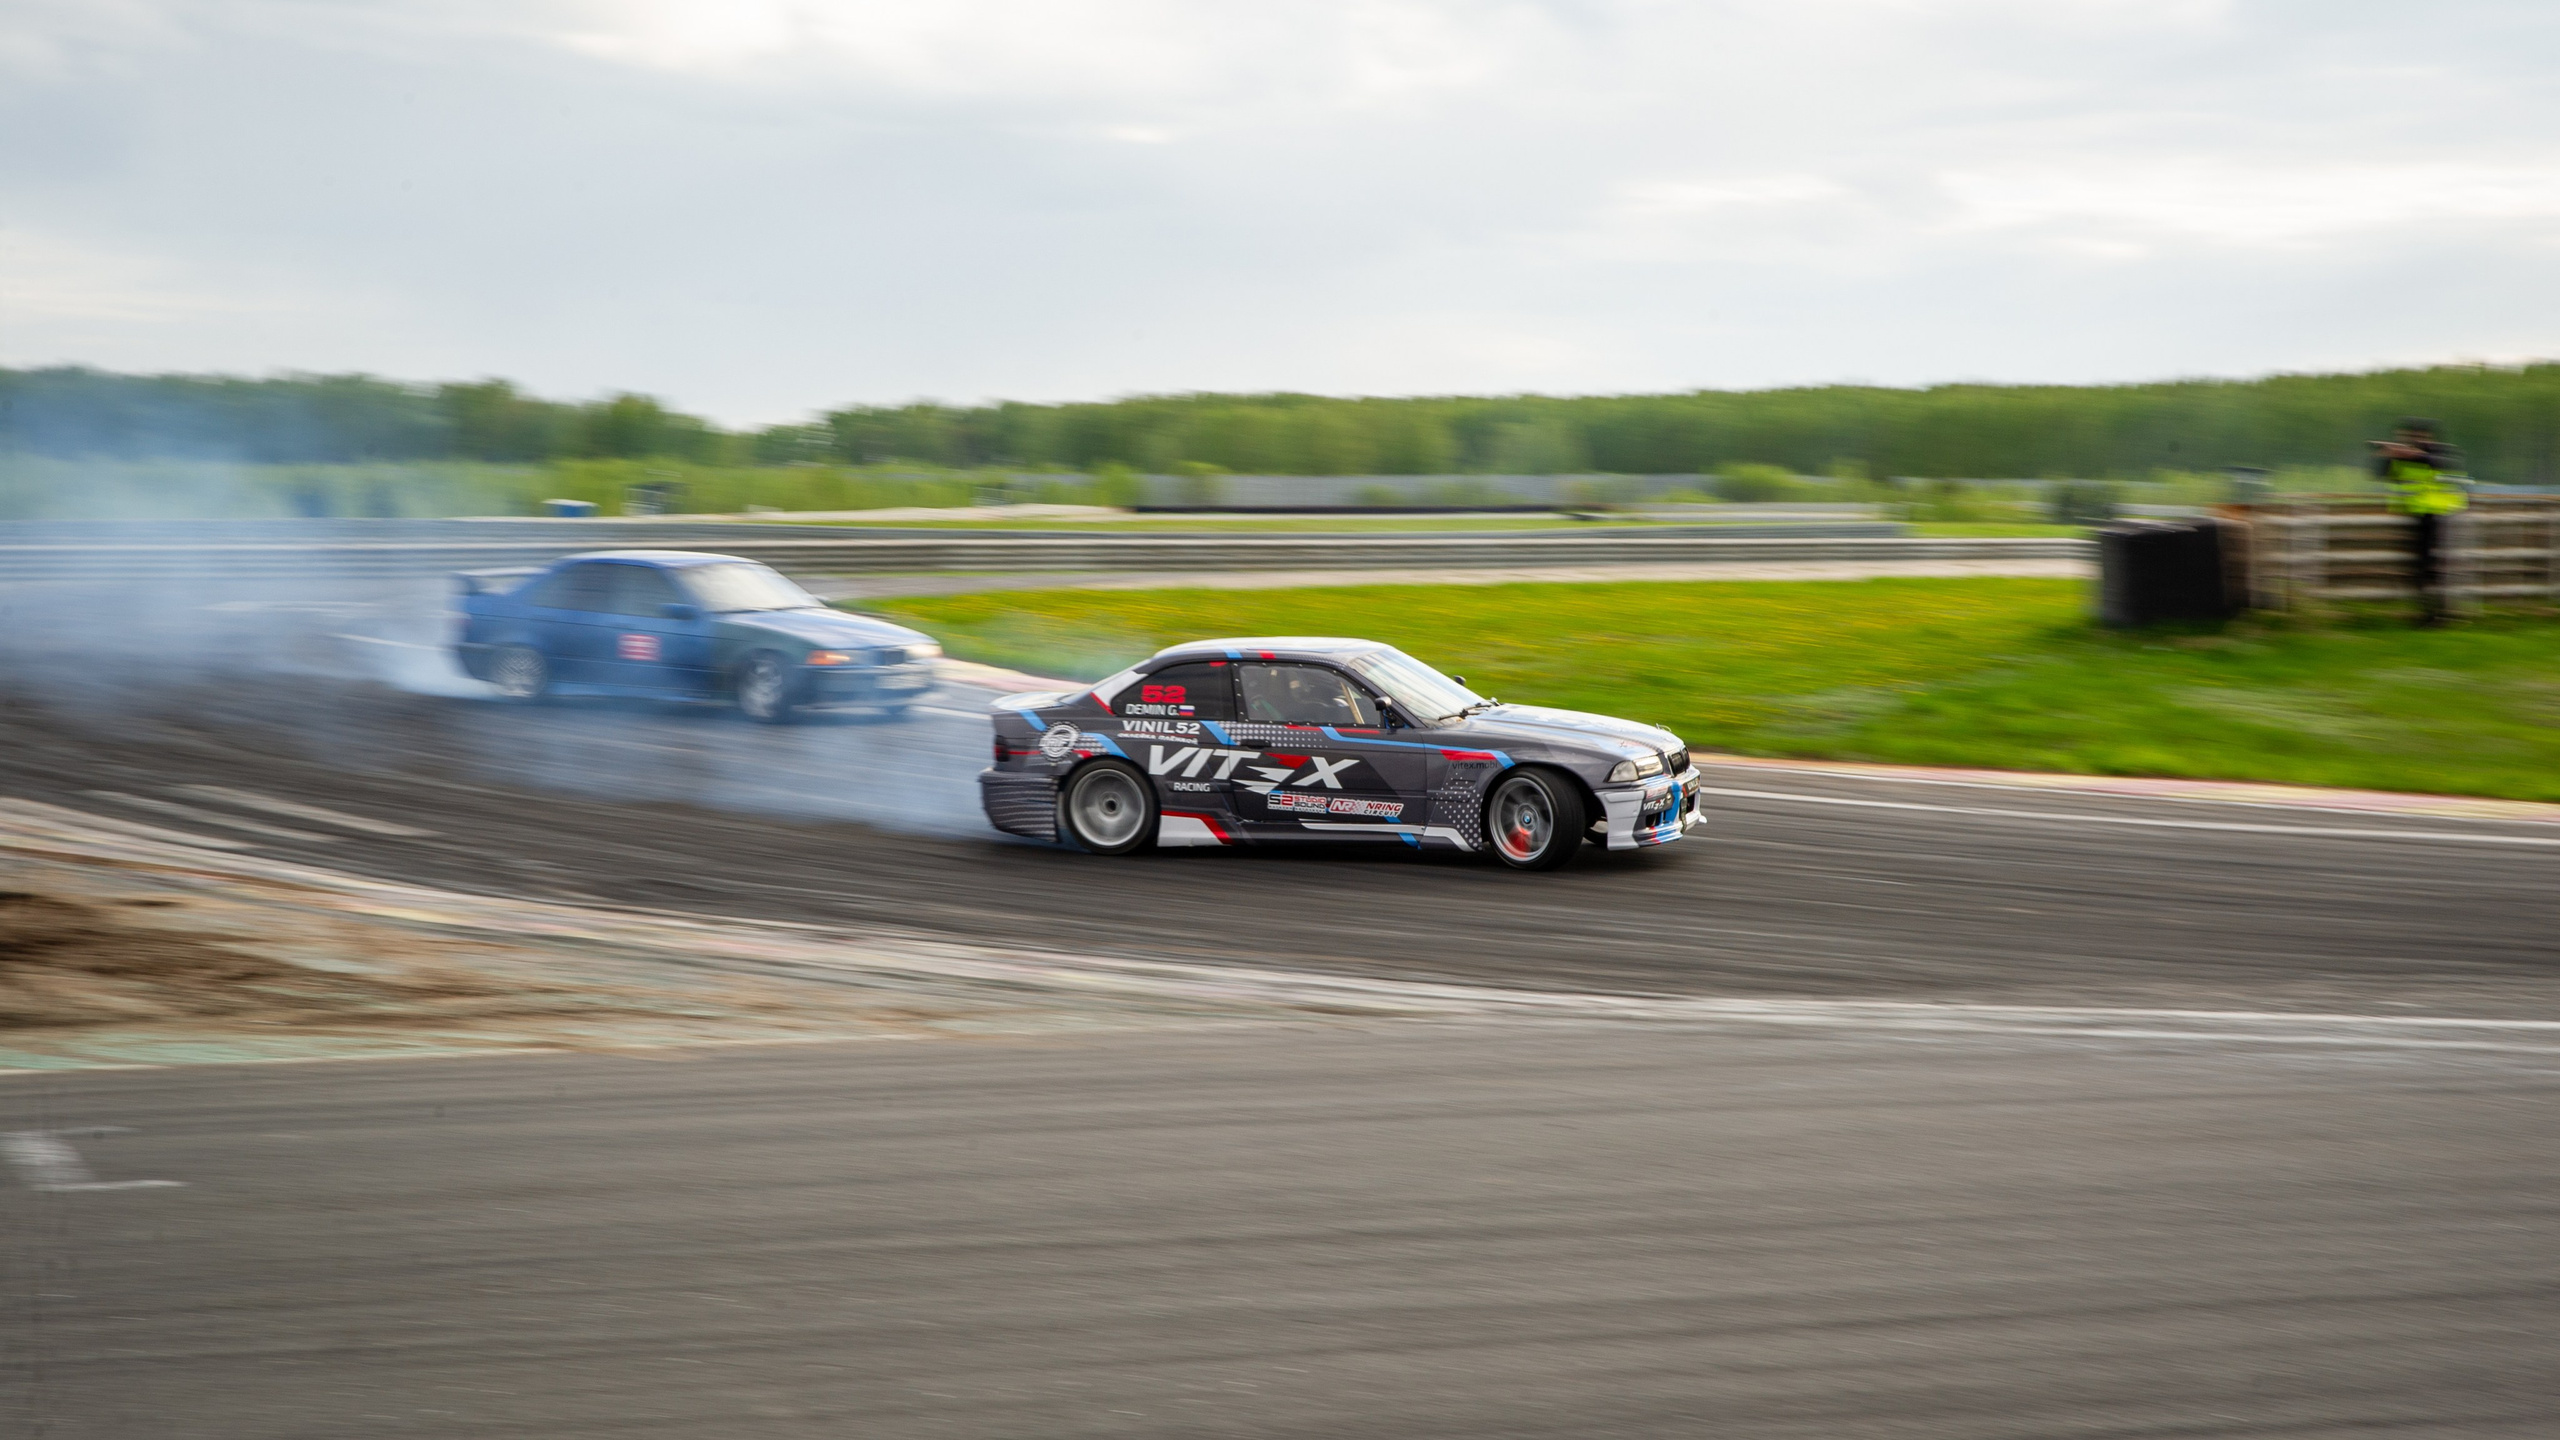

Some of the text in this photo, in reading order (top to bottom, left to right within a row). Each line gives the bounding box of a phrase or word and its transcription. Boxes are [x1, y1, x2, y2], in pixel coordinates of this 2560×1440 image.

[1141, 685, 1187, 704] 52
[1125, 703, 1166, 716] DEMIN
[1122, 720, 1200, 735] VINIL52
[1452, 761, 1498, 770] vitex.mobi
[1173, 782, 1211, 793] RACING
[1294, 795, 1327, 804] STUDIO
[1294, 801, 1326, 810] SOUND
[1332, 800, 1353, 812] NR
[1366, 802, 1402, 812] NRING
